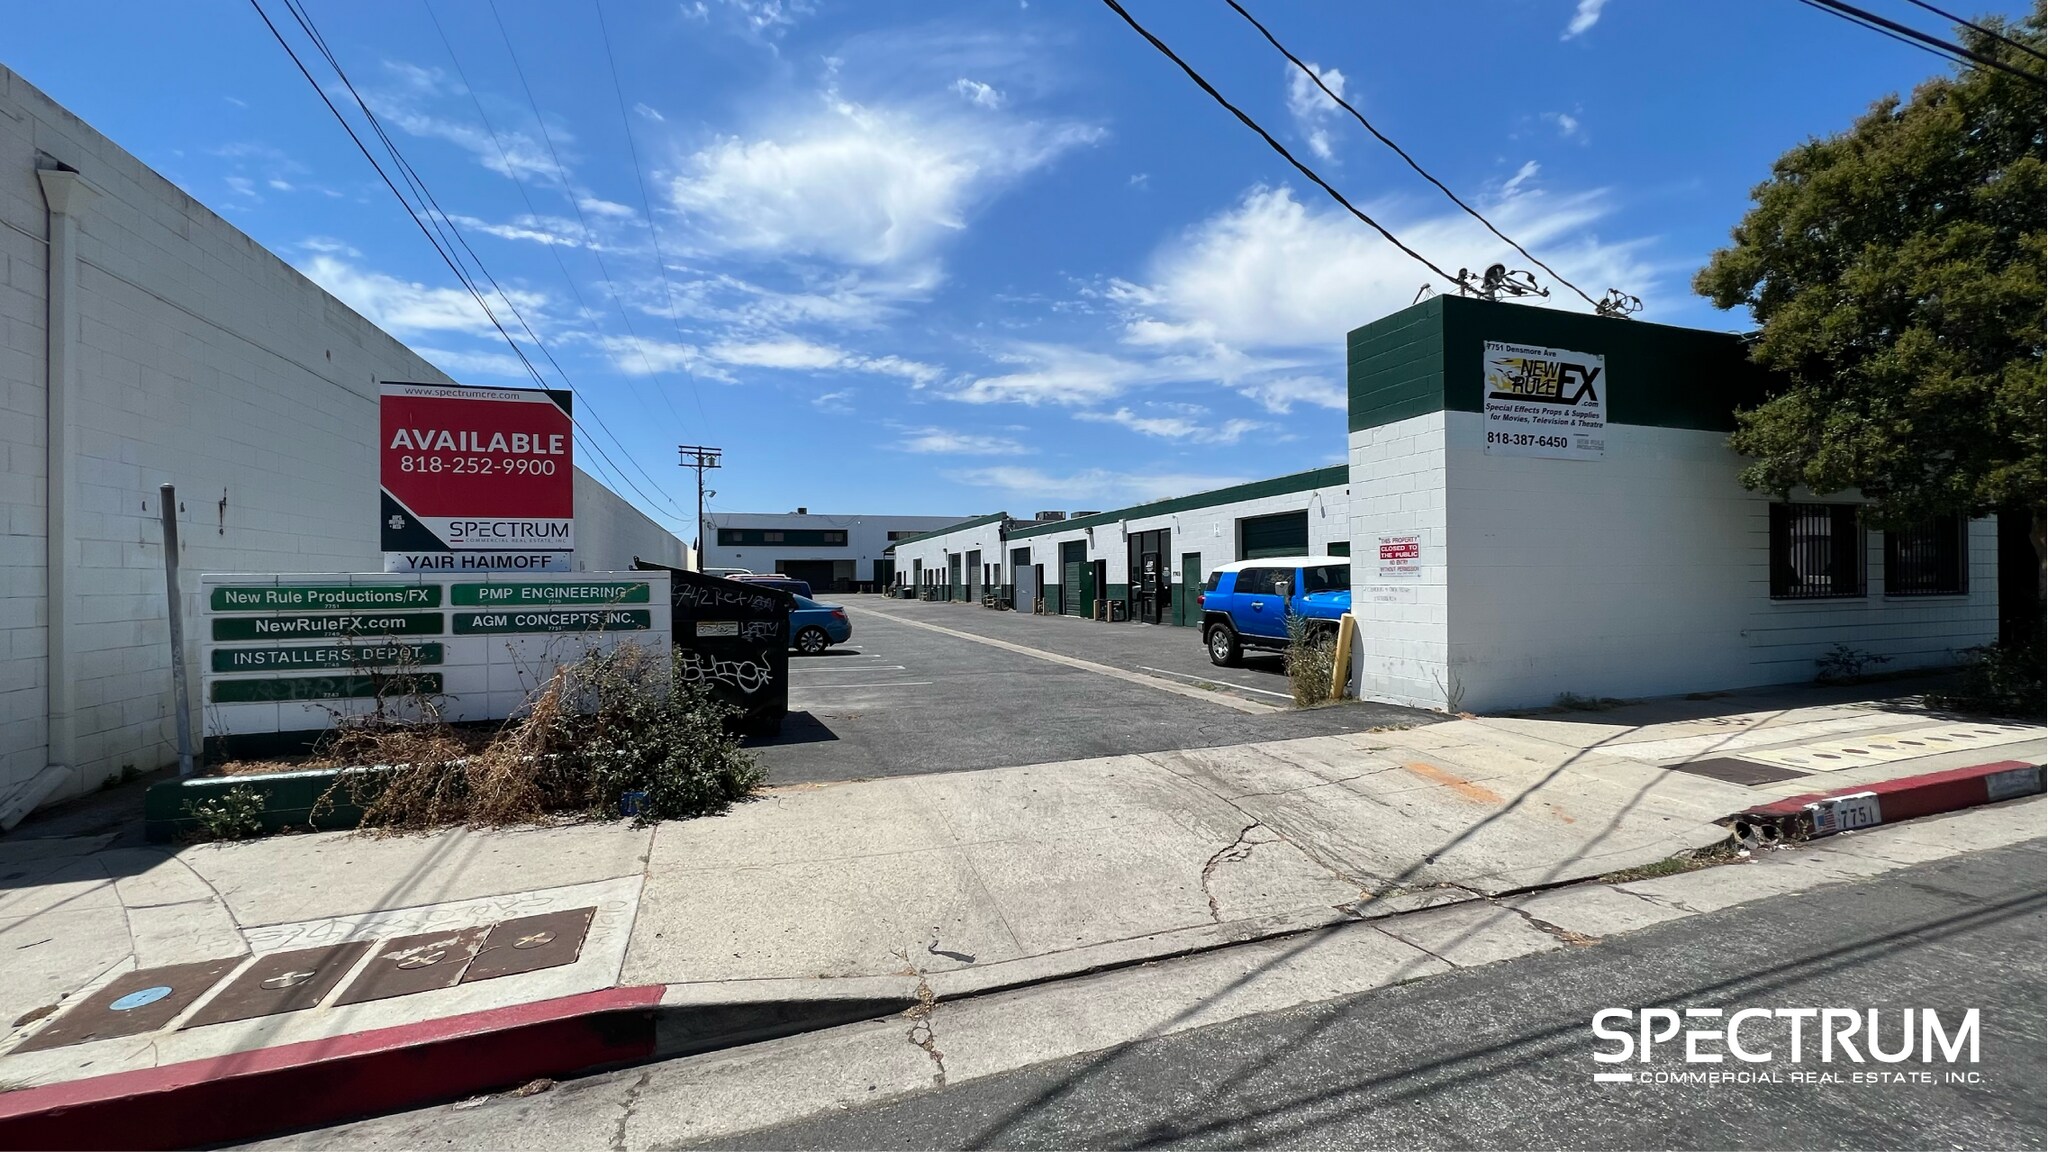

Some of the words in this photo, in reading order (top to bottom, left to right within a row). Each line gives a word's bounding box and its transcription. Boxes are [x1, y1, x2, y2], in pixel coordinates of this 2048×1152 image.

[1506, 345, 1541, 356] Densmore
[1543, 349, 1557, 357] Ave
[1520, 359, 1560, 378] NEW
[1512, 376, 1556, 395] RULE
[1557, 362, 1601, 402] FX
[404, 386, 520, 400] www.spectrumcre.com
[1485, 403, 1512, 413] Special
[1514, 405, 1540, 414] Effects
[1541, 408, 1562, 417] Props
[1571, 410, 1600, 419] Supplies
[1490, 412, 1501, 420] for
[1502, 414, 1530, 424] Movies,
[1532, 416, 1568, 426] Television
[1578, 420, 1604, 429] Theatre
[390, 428, 564, 455] AVAILABLE
[1487, 431, 1568, 449] 818-387-6450
[400, 455, 556, 476] 818-252-9900
[449, 521, 569, 538] SPECTRUM
[406, 555, 455, 569] YAIR
[462, 555, 552, 569] HAIMOFF
[225, 591, 261, 603] New
[266, 590, 302, 603] Rule
[308, 589, 429, 603] Productions/FX
[479, 587, 513, 599] PMP
[521, 586, 627, 598] ENGINEERING
[255, 617, 406, 633] NewRuleFX.com
[472, 615, 507, 627] AGM
[515, 613, 599, 626] CONCEPTS
[605, 612, 635, 624] INC.
[234, 649, 351, 664] INSTALLERS
[362, 646, 422, 660] DEPOT
[1841, 806, 1874, 829] 7751
